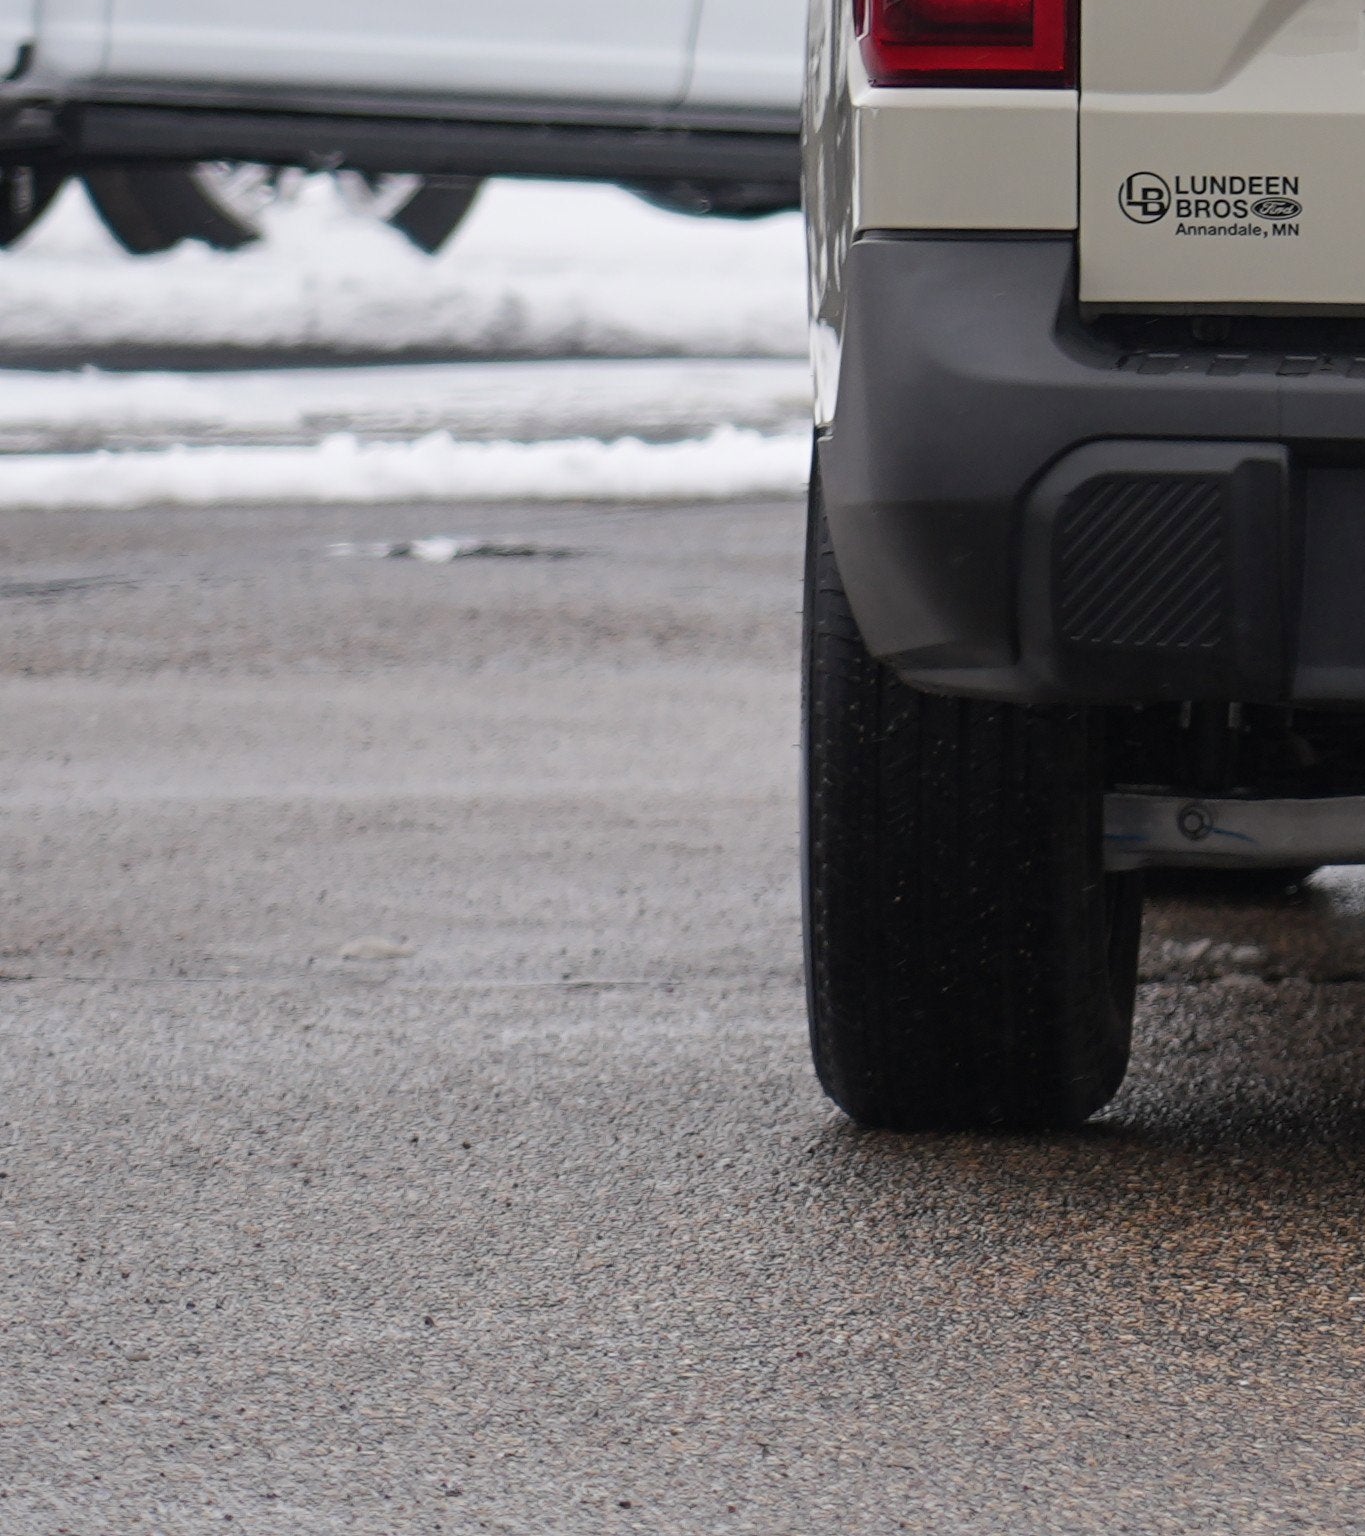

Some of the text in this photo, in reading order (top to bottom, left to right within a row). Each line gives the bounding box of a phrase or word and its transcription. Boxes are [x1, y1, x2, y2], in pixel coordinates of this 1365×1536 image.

[1174, 175, 1299, 195] LUNDEEN
[1175, 199, 1249, 219] BROS
[1175, 223, 1300, 239] Annandale, MN
